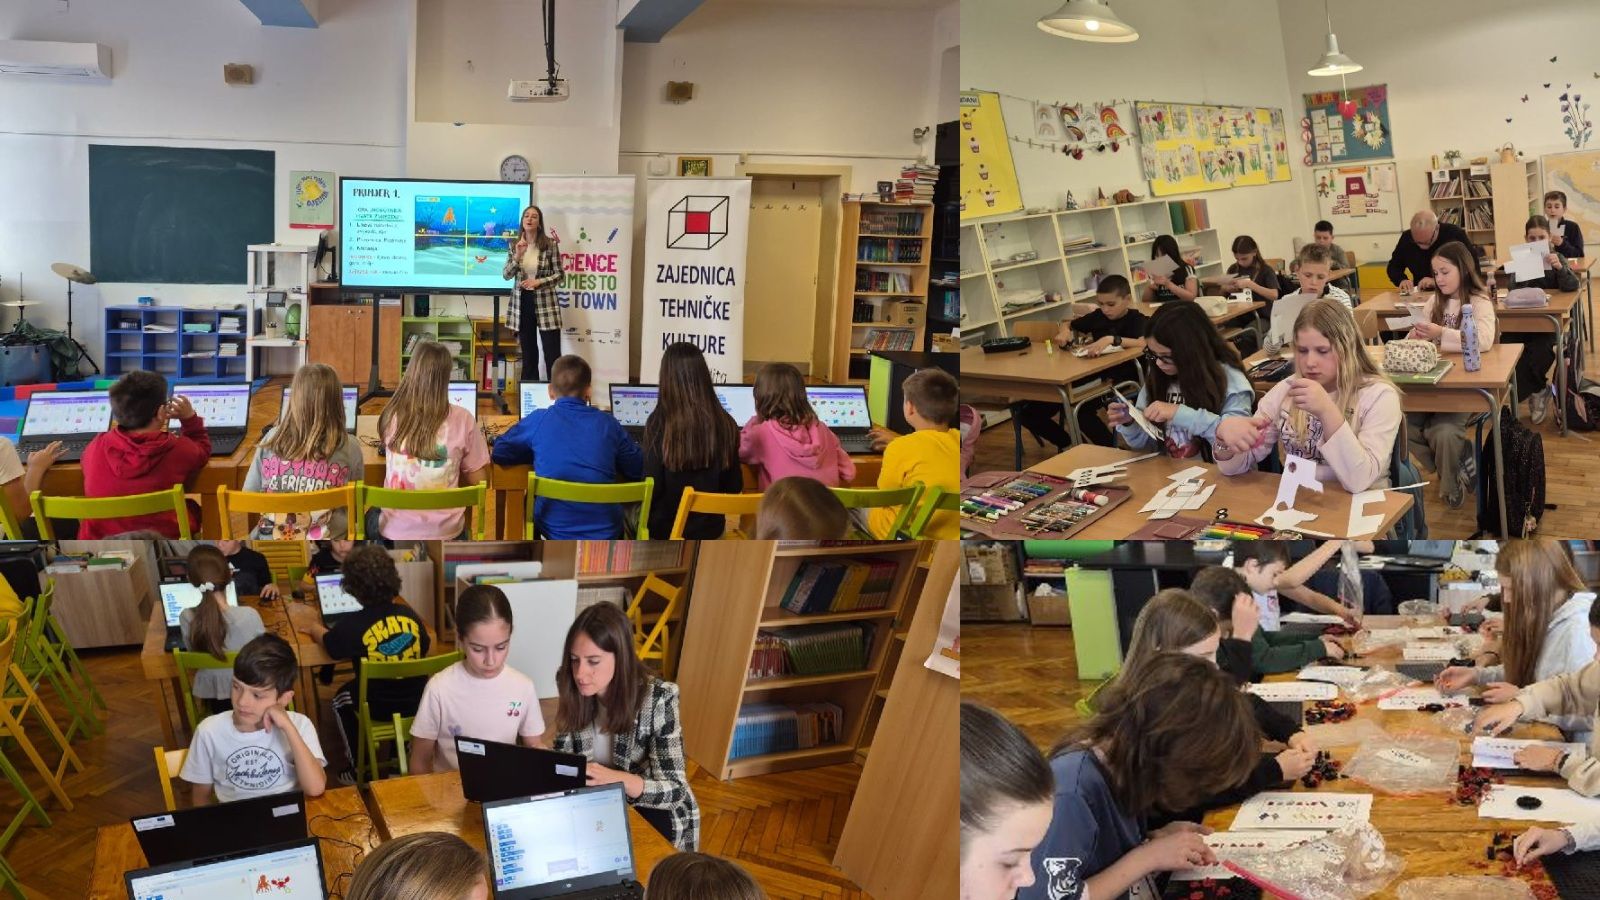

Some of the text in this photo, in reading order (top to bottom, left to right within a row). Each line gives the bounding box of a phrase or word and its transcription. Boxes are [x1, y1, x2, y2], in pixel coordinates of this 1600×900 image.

[559, 253, 618, 272] CIENCE
[558, 274, 617, 291] OMES TO
[656, 264, 736, 286] ZAJEDNICA
[572, 292, 617, 310] TOWN
[660, 295, 730, 321] TEHNIČKE
[231, 749, 274, 764] ORIGINALS
